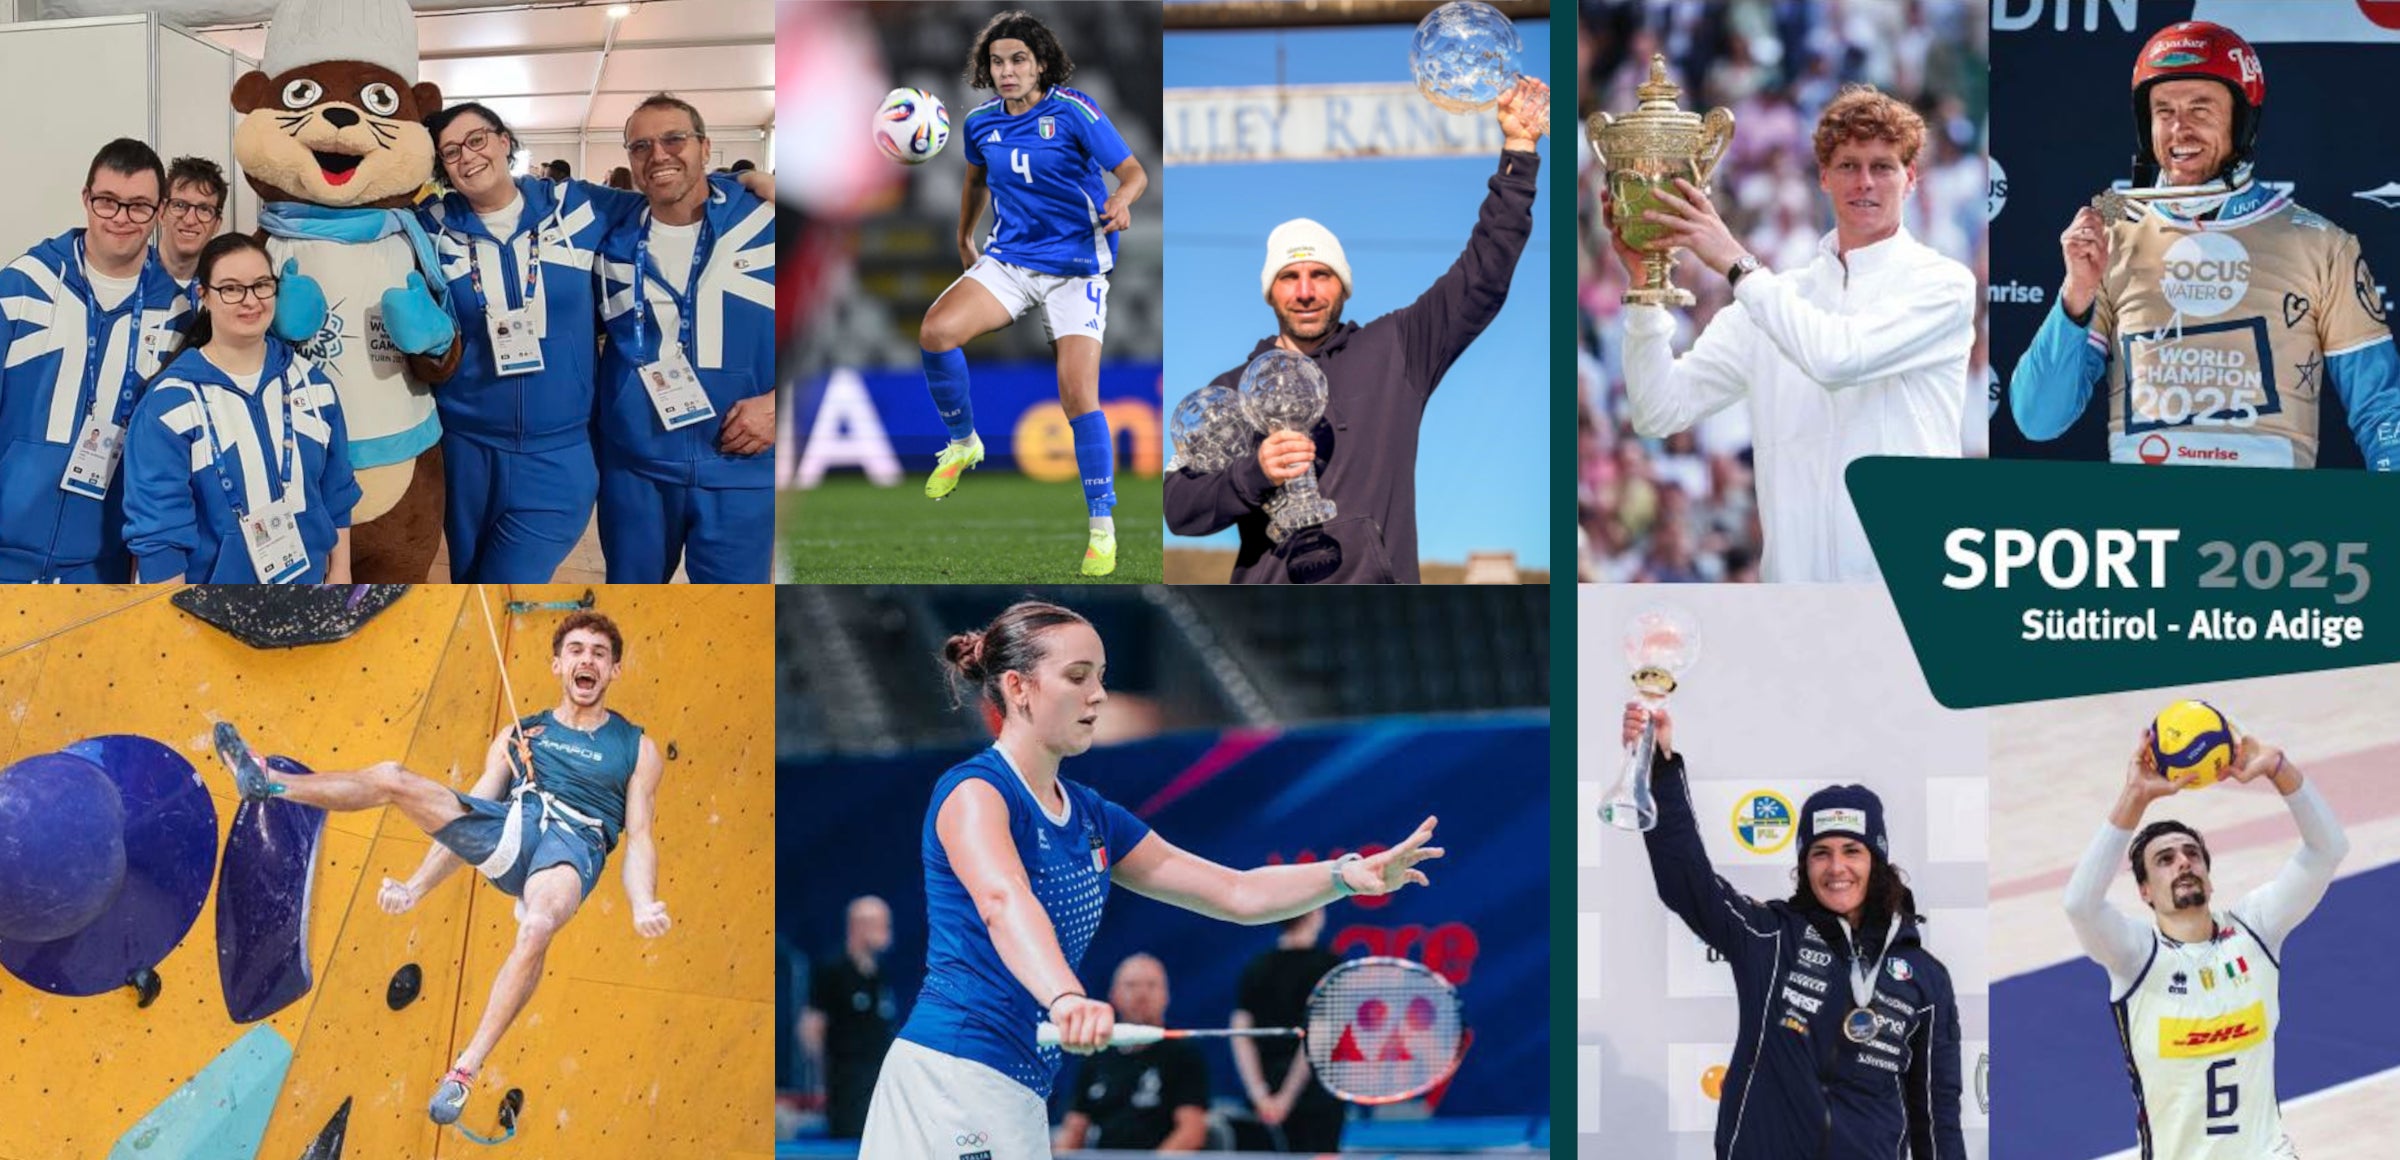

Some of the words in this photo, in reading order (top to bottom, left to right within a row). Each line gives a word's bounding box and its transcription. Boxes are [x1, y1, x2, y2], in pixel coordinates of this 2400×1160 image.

[1011, 148, 1033, 183] 4
[1086, 281, 1101, 315] 4
[2158, 349, 2245, 368] WORLD
[2132, 365, 2262, 389] CHAMPION
[2131, 385, 2259, 427] 2025
[2177, 446, 2239, 461] Sunrise
[2187, 1022, 2248, 1046] DHL
[2206, 1057, 2238, 1119] 6
